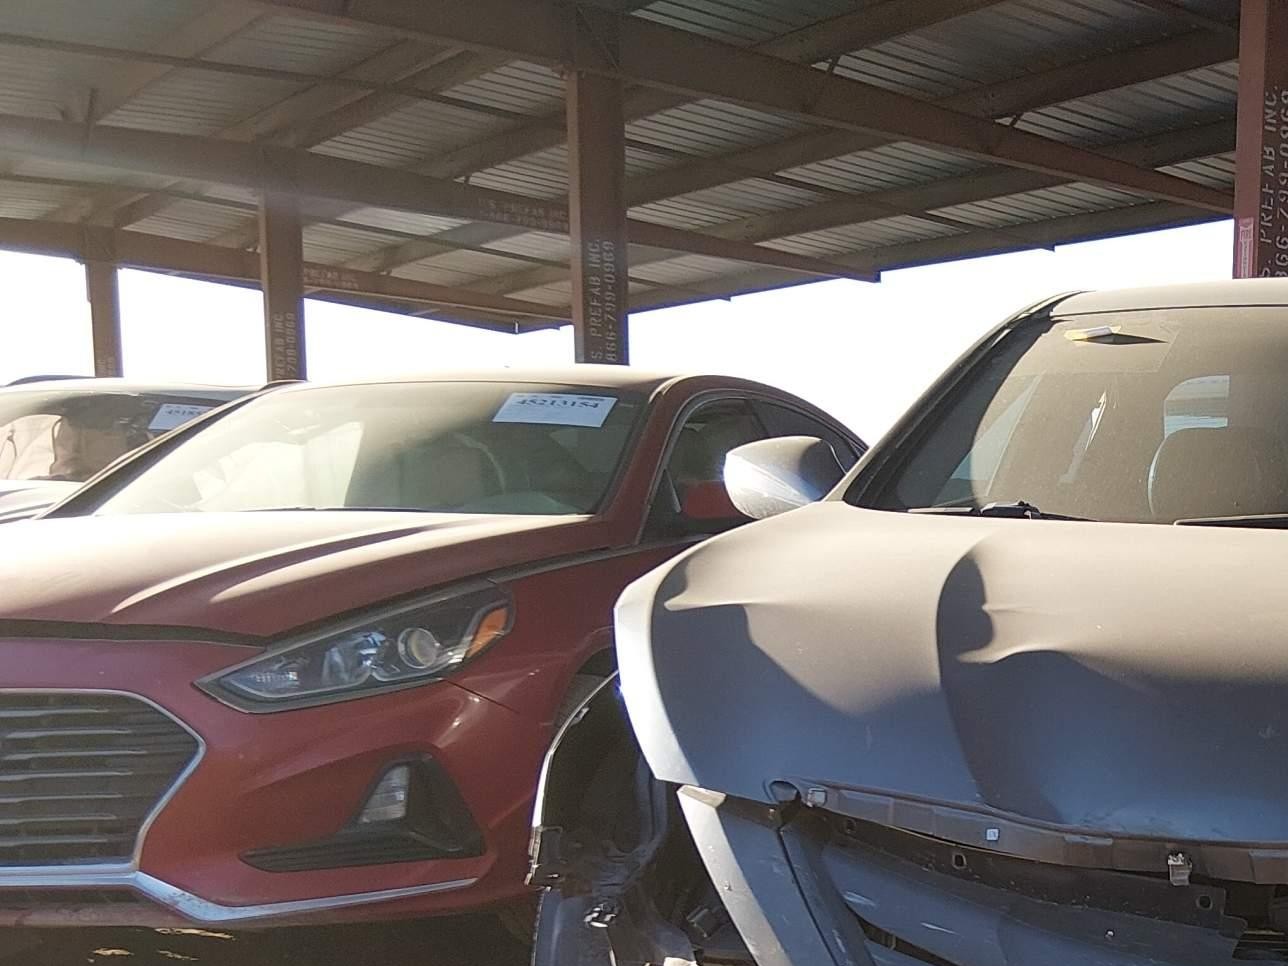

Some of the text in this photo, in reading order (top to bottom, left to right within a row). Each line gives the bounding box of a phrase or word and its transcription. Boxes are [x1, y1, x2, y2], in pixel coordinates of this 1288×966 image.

[1264, 85, 1279, 132] INC.
[1260, 146, 1276, 244] PREFAB
[589, 275, 602, 338] PREFAB
